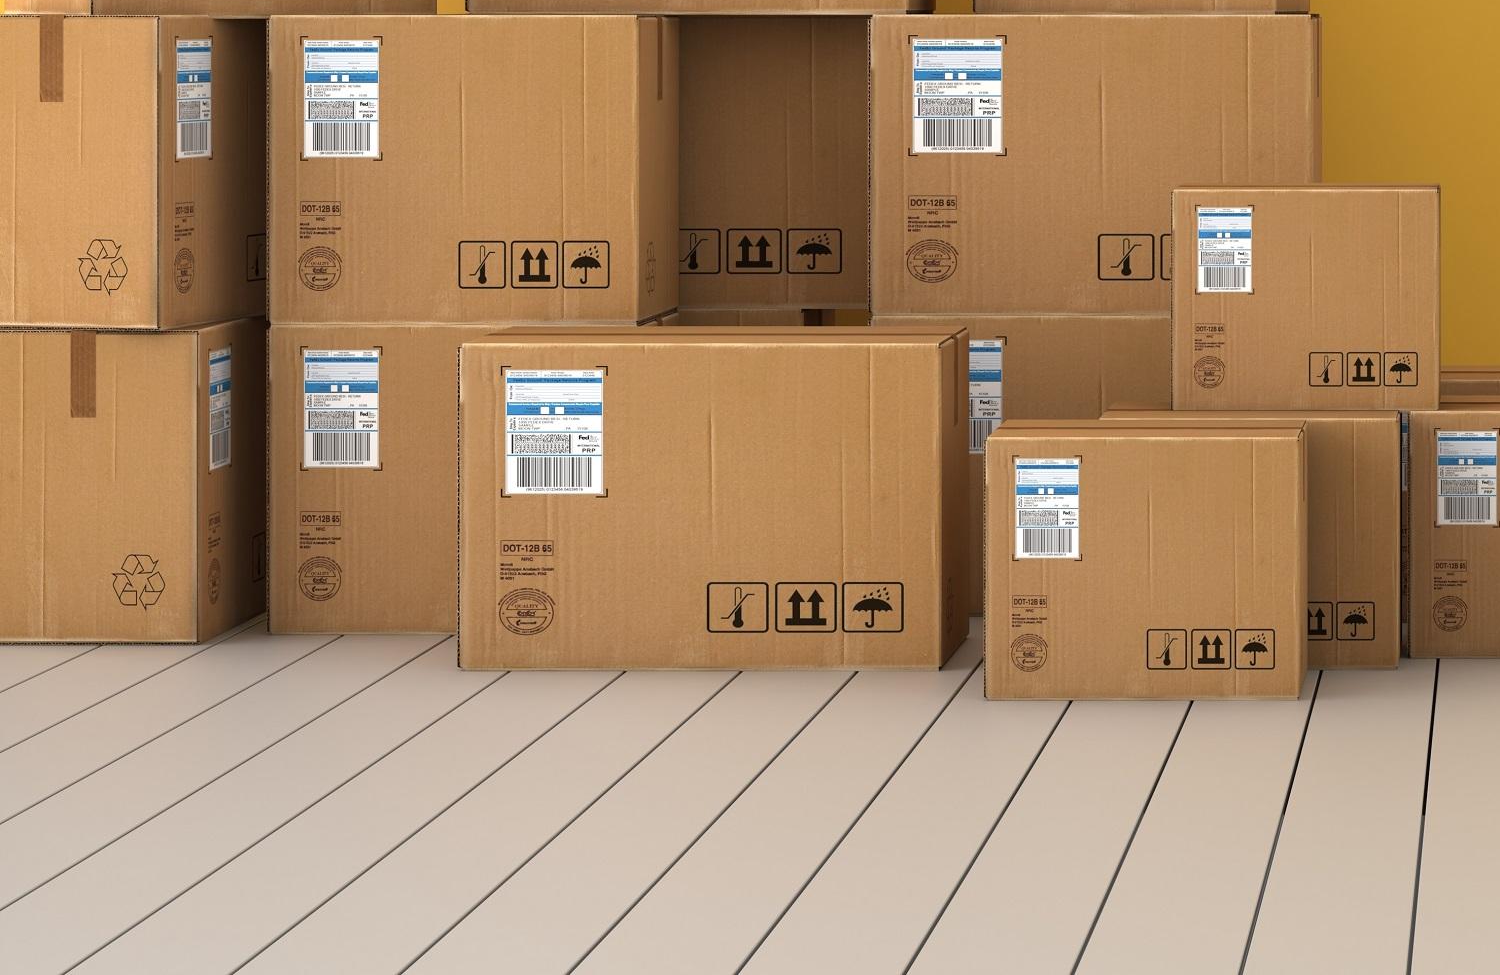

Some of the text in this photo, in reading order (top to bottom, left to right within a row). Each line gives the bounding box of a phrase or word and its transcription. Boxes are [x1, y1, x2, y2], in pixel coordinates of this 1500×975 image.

[910, 199, 944, 207] DOT-12B
[302, 205, 330, 213] DOT-12B
[302, 515, 330, 523] DOT-12B
[503, 544, 540, 552] DOT-12B
